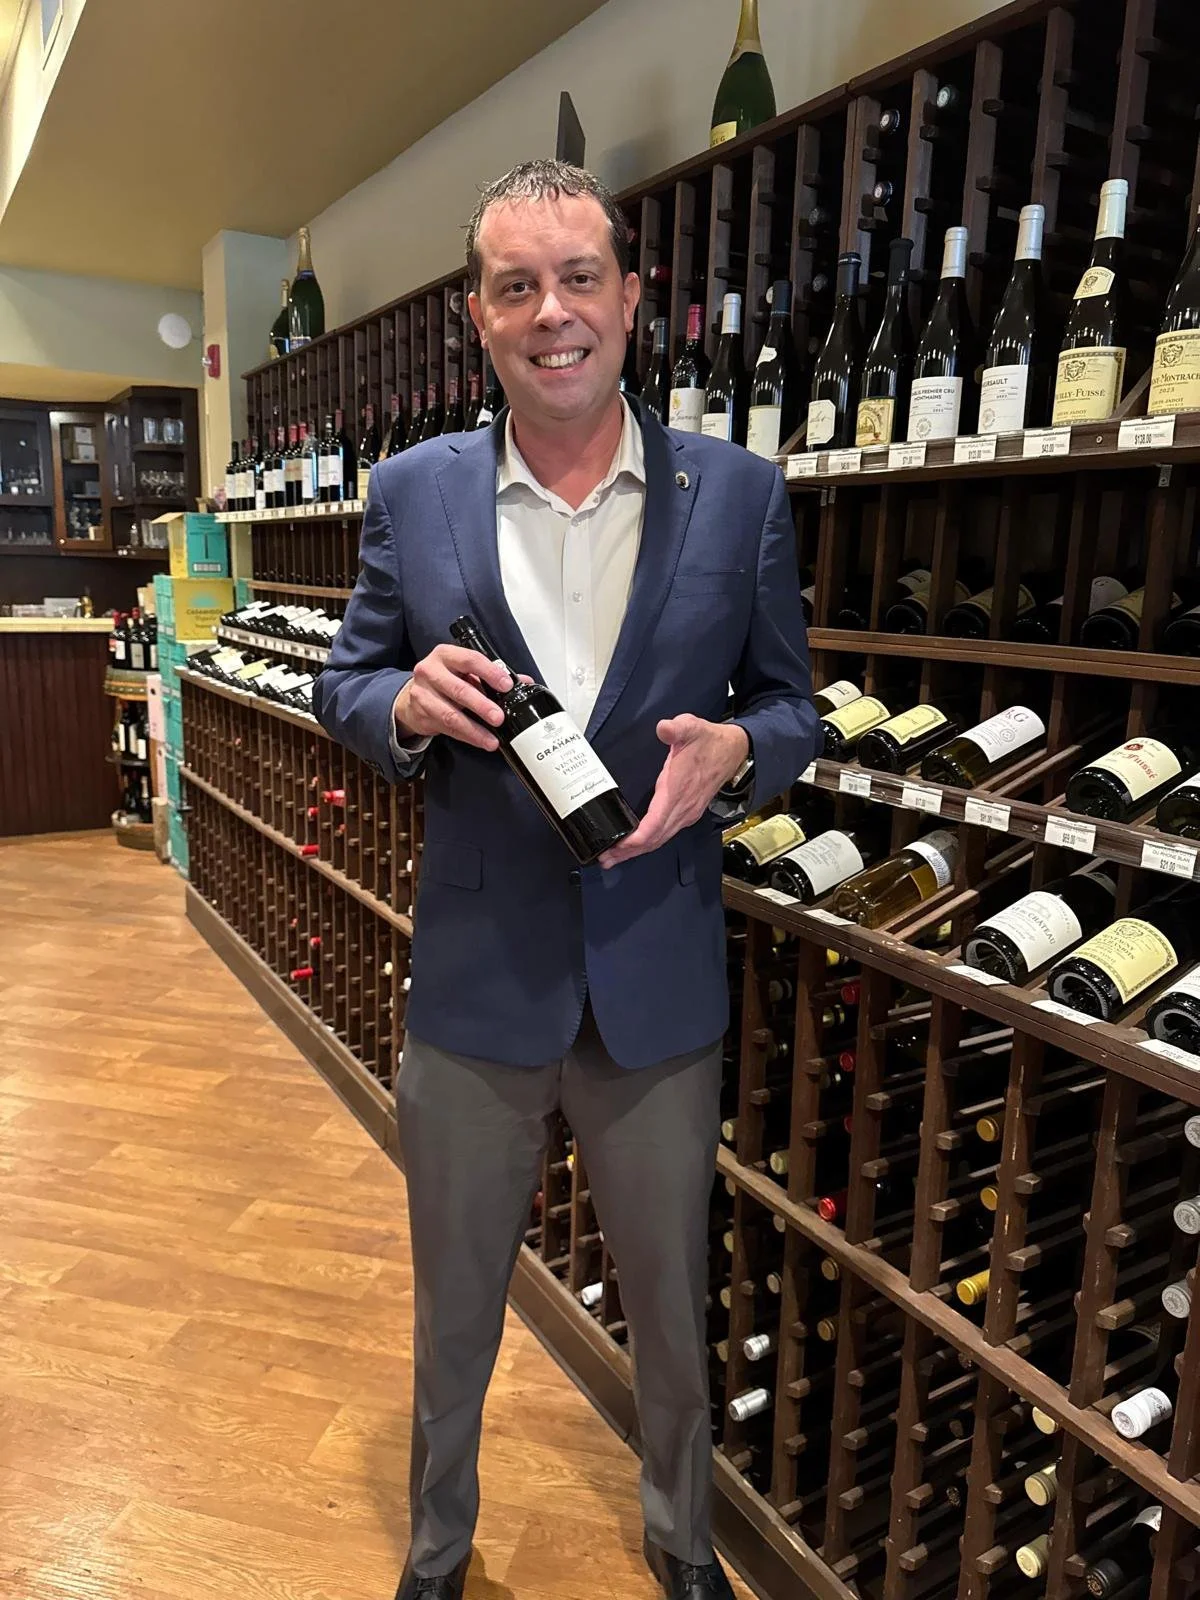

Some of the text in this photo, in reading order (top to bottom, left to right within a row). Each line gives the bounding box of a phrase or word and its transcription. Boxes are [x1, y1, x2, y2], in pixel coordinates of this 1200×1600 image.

[536, 733, 581, 761] GRAHAM'S
[555, 752, 586, 771] VINTAGE
[562, 759, 588, 775] PORTO
